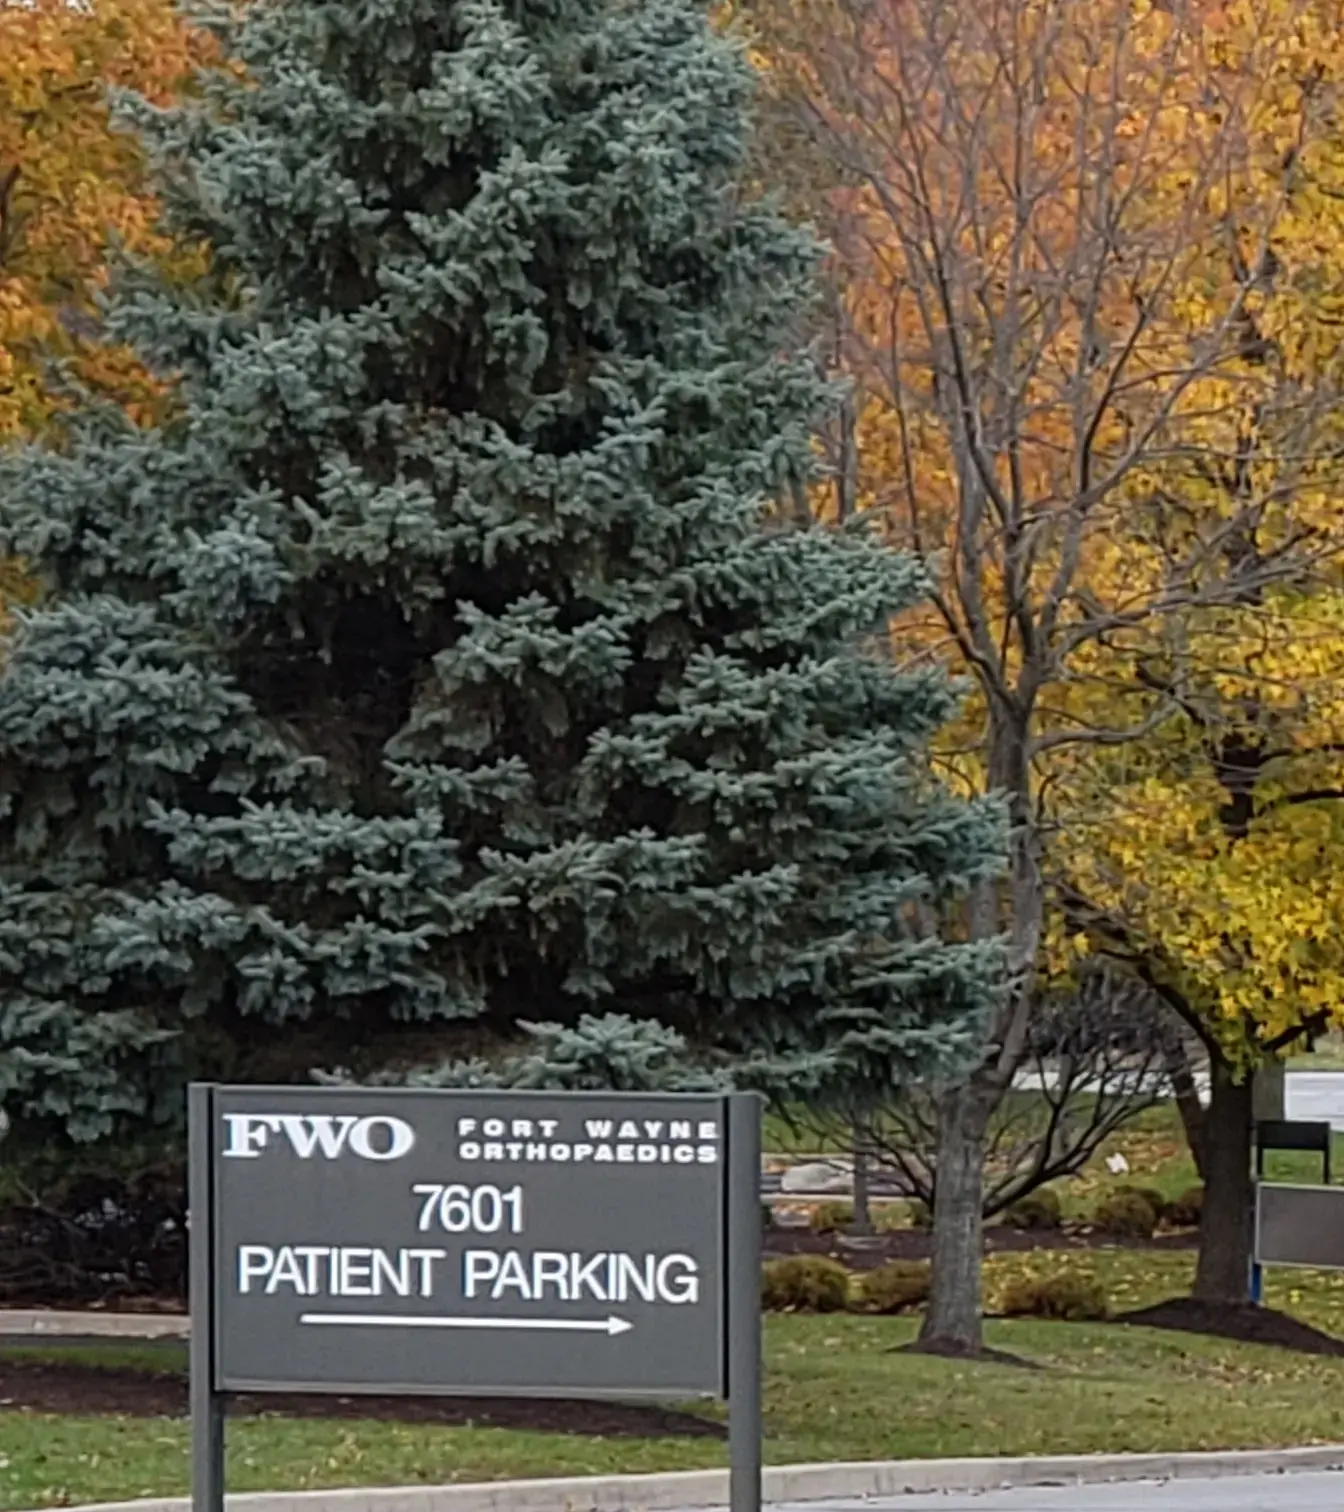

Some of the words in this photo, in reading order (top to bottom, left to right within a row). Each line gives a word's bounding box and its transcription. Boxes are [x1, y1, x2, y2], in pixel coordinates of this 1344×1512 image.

[222, 1113, 415, 1160] FWO
[458, 1118, 559, 1138] FORT
[585, 1119, 718, 1140] WAYNE
[458, 1142, 718, 1164] ORTHOPAEDICS
[412, 1184, 524, 1233] 7601
[237, 1246, 447, 1297] PATIENT
[463, 1250, 699, 1304] PARKING
